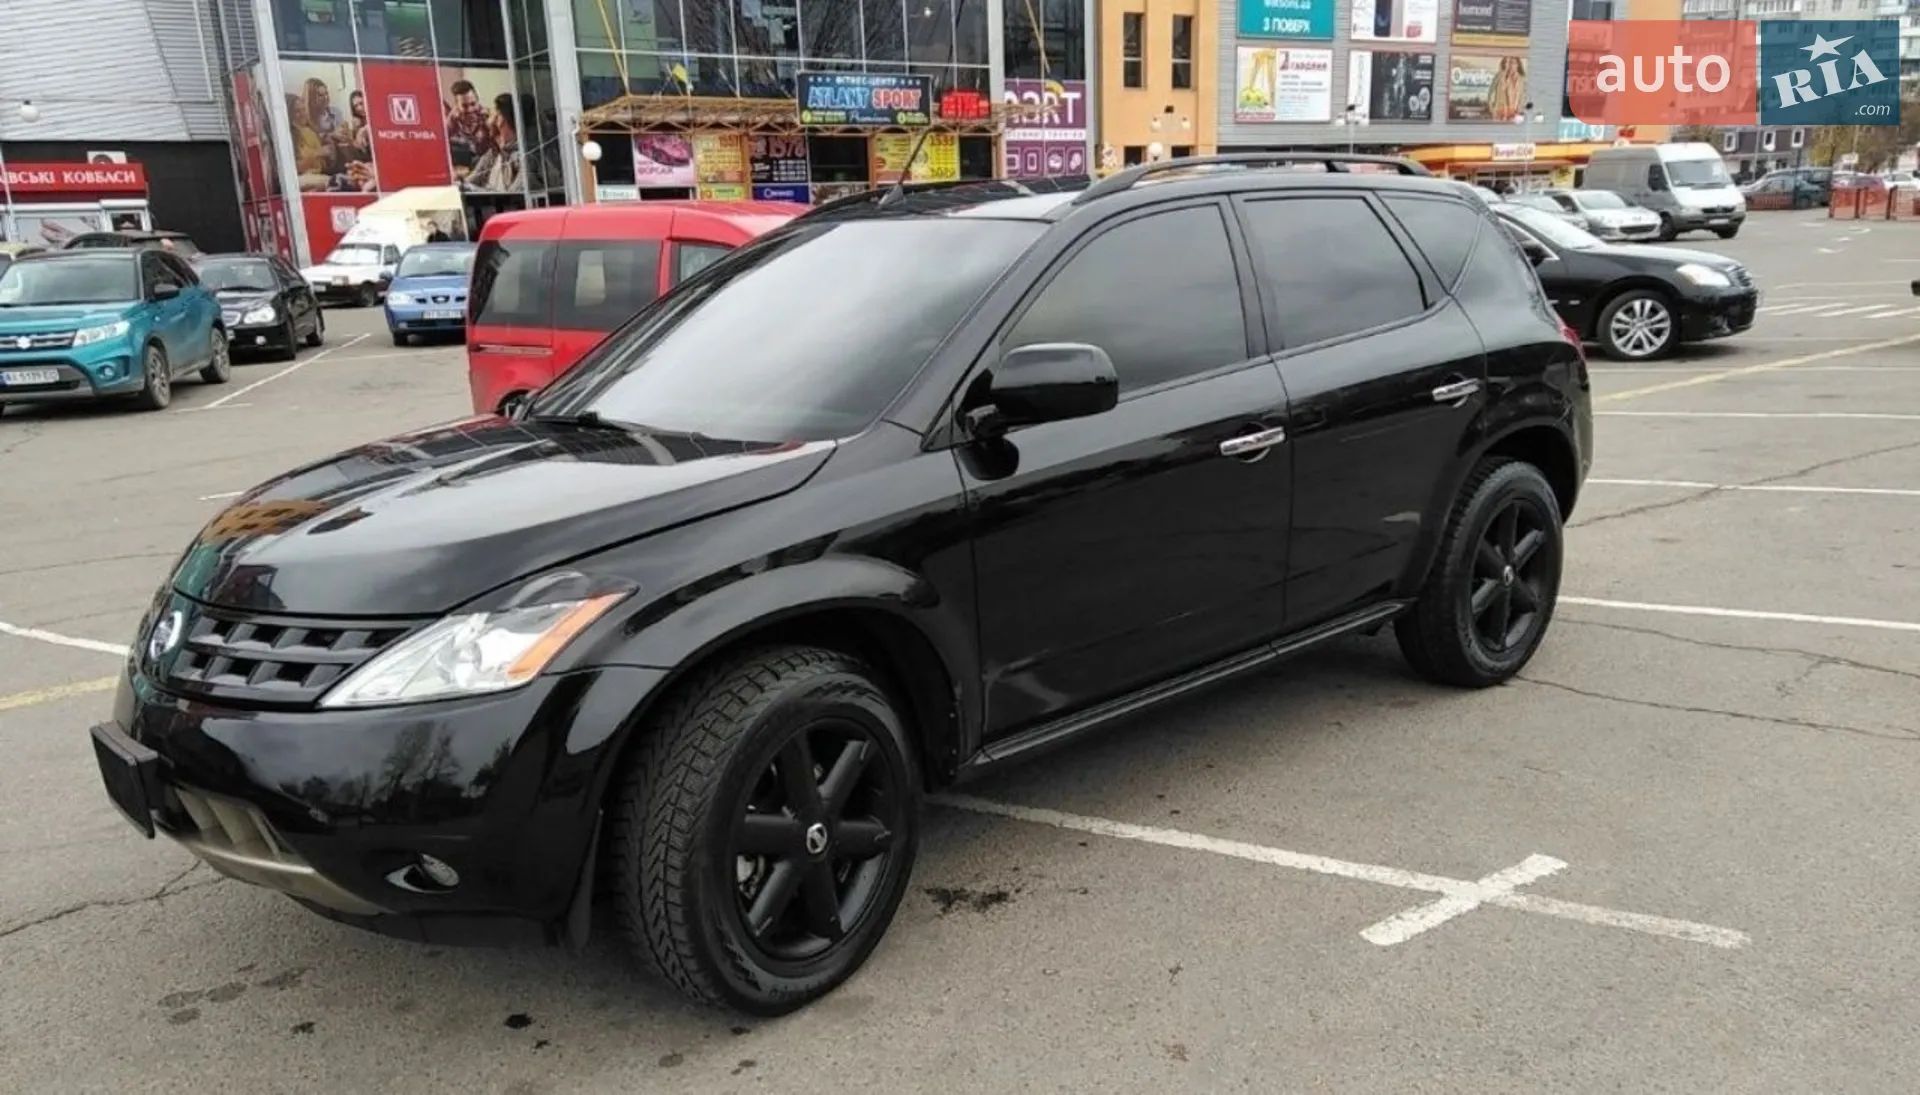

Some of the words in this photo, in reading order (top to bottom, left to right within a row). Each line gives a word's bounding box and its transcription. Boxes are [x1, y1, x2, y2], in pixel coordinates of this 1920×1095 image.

[1272, 18, 1310, 33] ПОВЕРХ
[807, 86, 869, 109] ATLANT
[872, 88, 921, 110] SPORT
[378, 130, 405, 140] МОРЕ
[408, 131, 437, 140] ПИВА
[62, 170, 136, 184] КОВБАСИ
